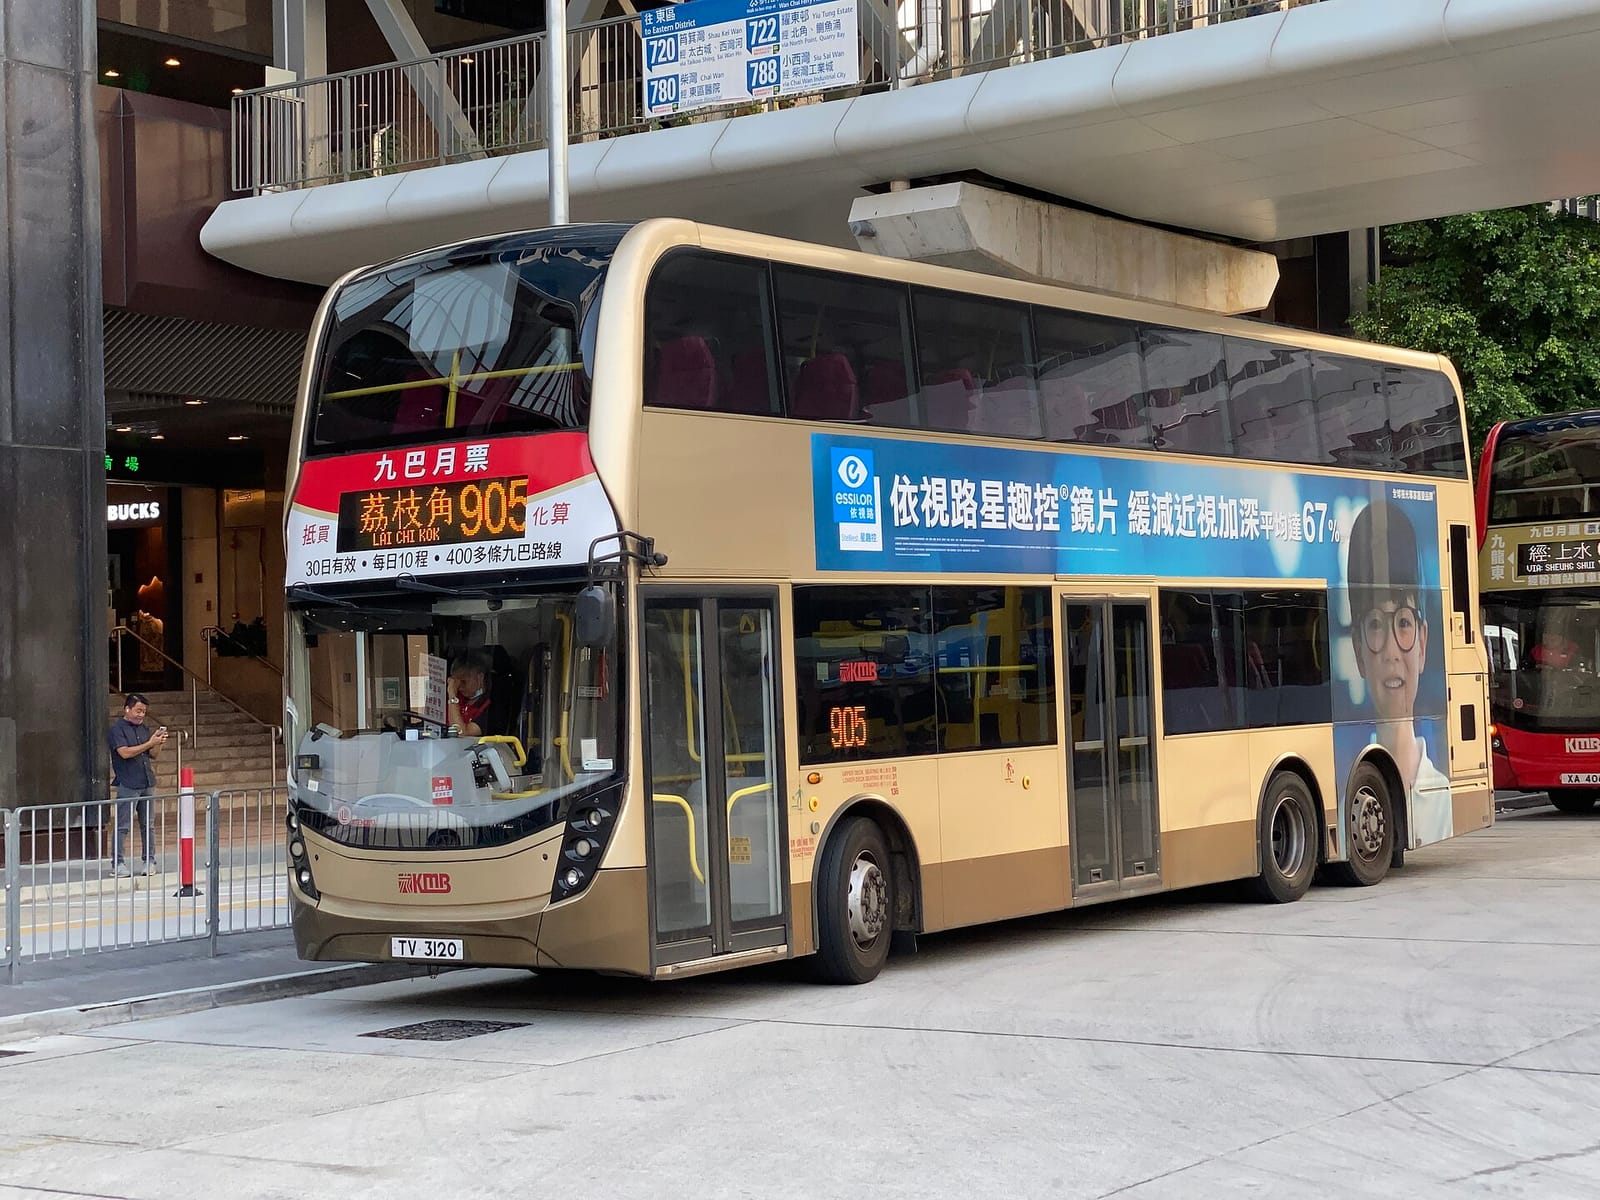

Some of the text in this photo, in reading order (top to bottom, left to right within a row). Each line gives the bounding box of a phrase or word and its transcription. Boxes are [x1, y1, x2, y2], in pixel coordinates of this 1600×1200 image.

[655, 7, 676, 23] 東區
[652, 24, 674, 34] Eastern
[674, 20, 696, 30] District
[749, 18, 777, 45] 722
[649, 37, 676, 64] 720
[700, 73, 712, 81] Chai
[750, 59, 777, 87] 788
[650, 78, 676, 104] 780
[373, 444, 490, 482] 九巴月票
[107, 502, 160, 521] BUCKS
[360, 479, 528, 536] 荔枝角 905
[532, 501, 571, 527] 化算
[372, 527, 440, 547] LAI CHI KOK
[305, 542, 562, 577] 30日有效 每日10程 400多條九巴路線
[1555, 542, 1592, 560] 上水
[1545, 562, 1575, 571] SHEUNG
[1576, 561, 1595, 570] SHUI
[849, 661, 877, 681] KMB
[830, 706, 868, 748] 905
[1565, 737, 1600, 753] KMB
[1567, 774, 1600, 783] XA 40
[411, 873, 452, 894] KMB
[398, 940, 457, 957] TV 3120
